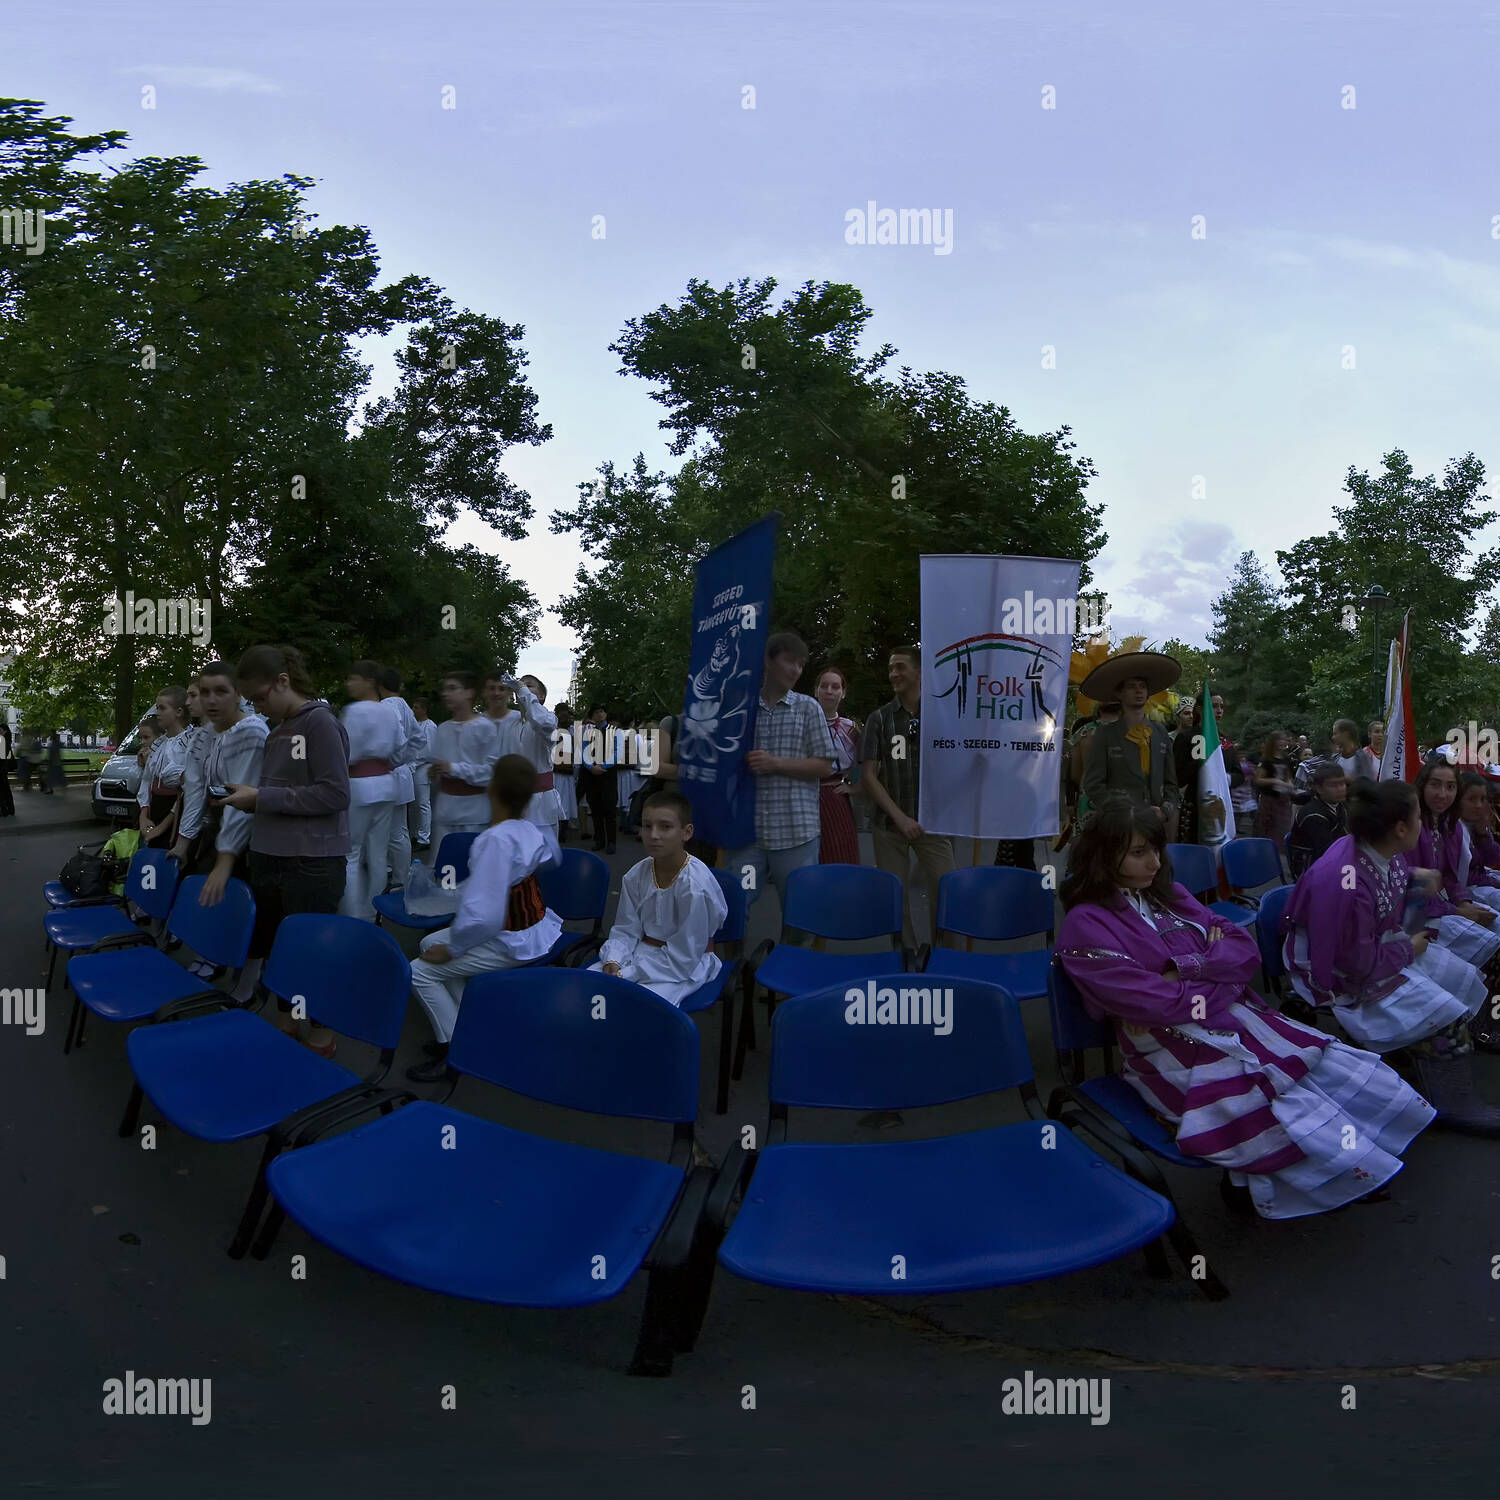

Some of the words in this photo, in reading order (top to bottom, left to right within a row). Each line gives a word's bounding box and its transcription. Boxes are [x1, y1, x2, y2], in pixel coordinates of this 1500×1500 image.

[976, 674, 1026, 697] Folk
[976, 697, 1024, 721] Híd
[933, 736, 956, 749] PÉCS
[963, 739, 1001, 749] SZEGED
